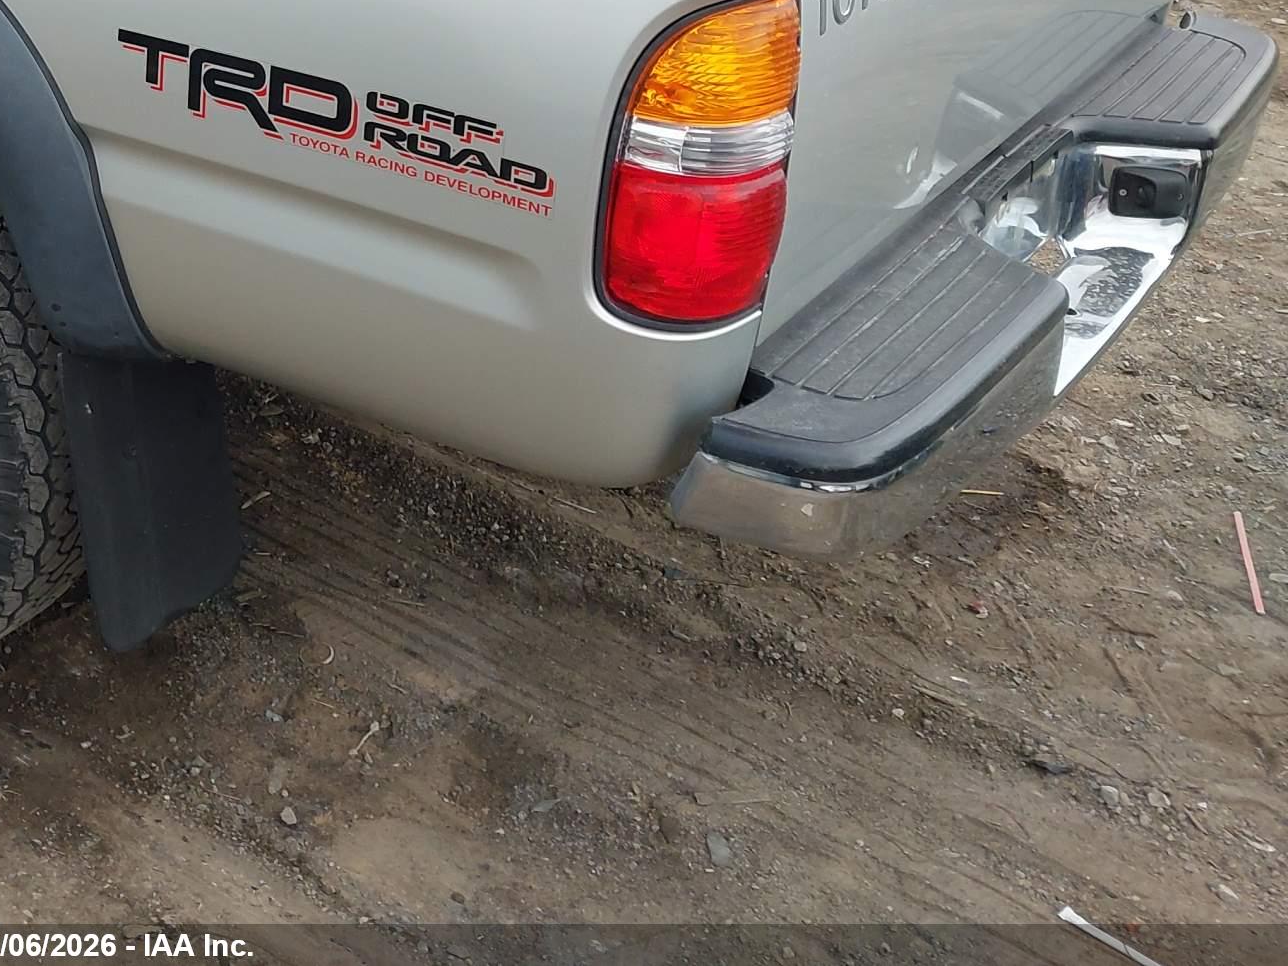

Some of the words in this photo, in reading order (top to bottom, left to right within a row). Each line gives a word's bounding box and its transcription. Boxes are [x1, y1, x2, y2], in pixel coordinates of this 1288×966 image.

[117, 28, 360, 141] TRD
[365, 90, 504, 144] OFF
[289, 132, 350, 159] TOYOTA
[354, 150, 418, 178] RACING
[423, 169, 553, 217] DEVELOPMENT
[362, 120, 554, 198] ROAD
